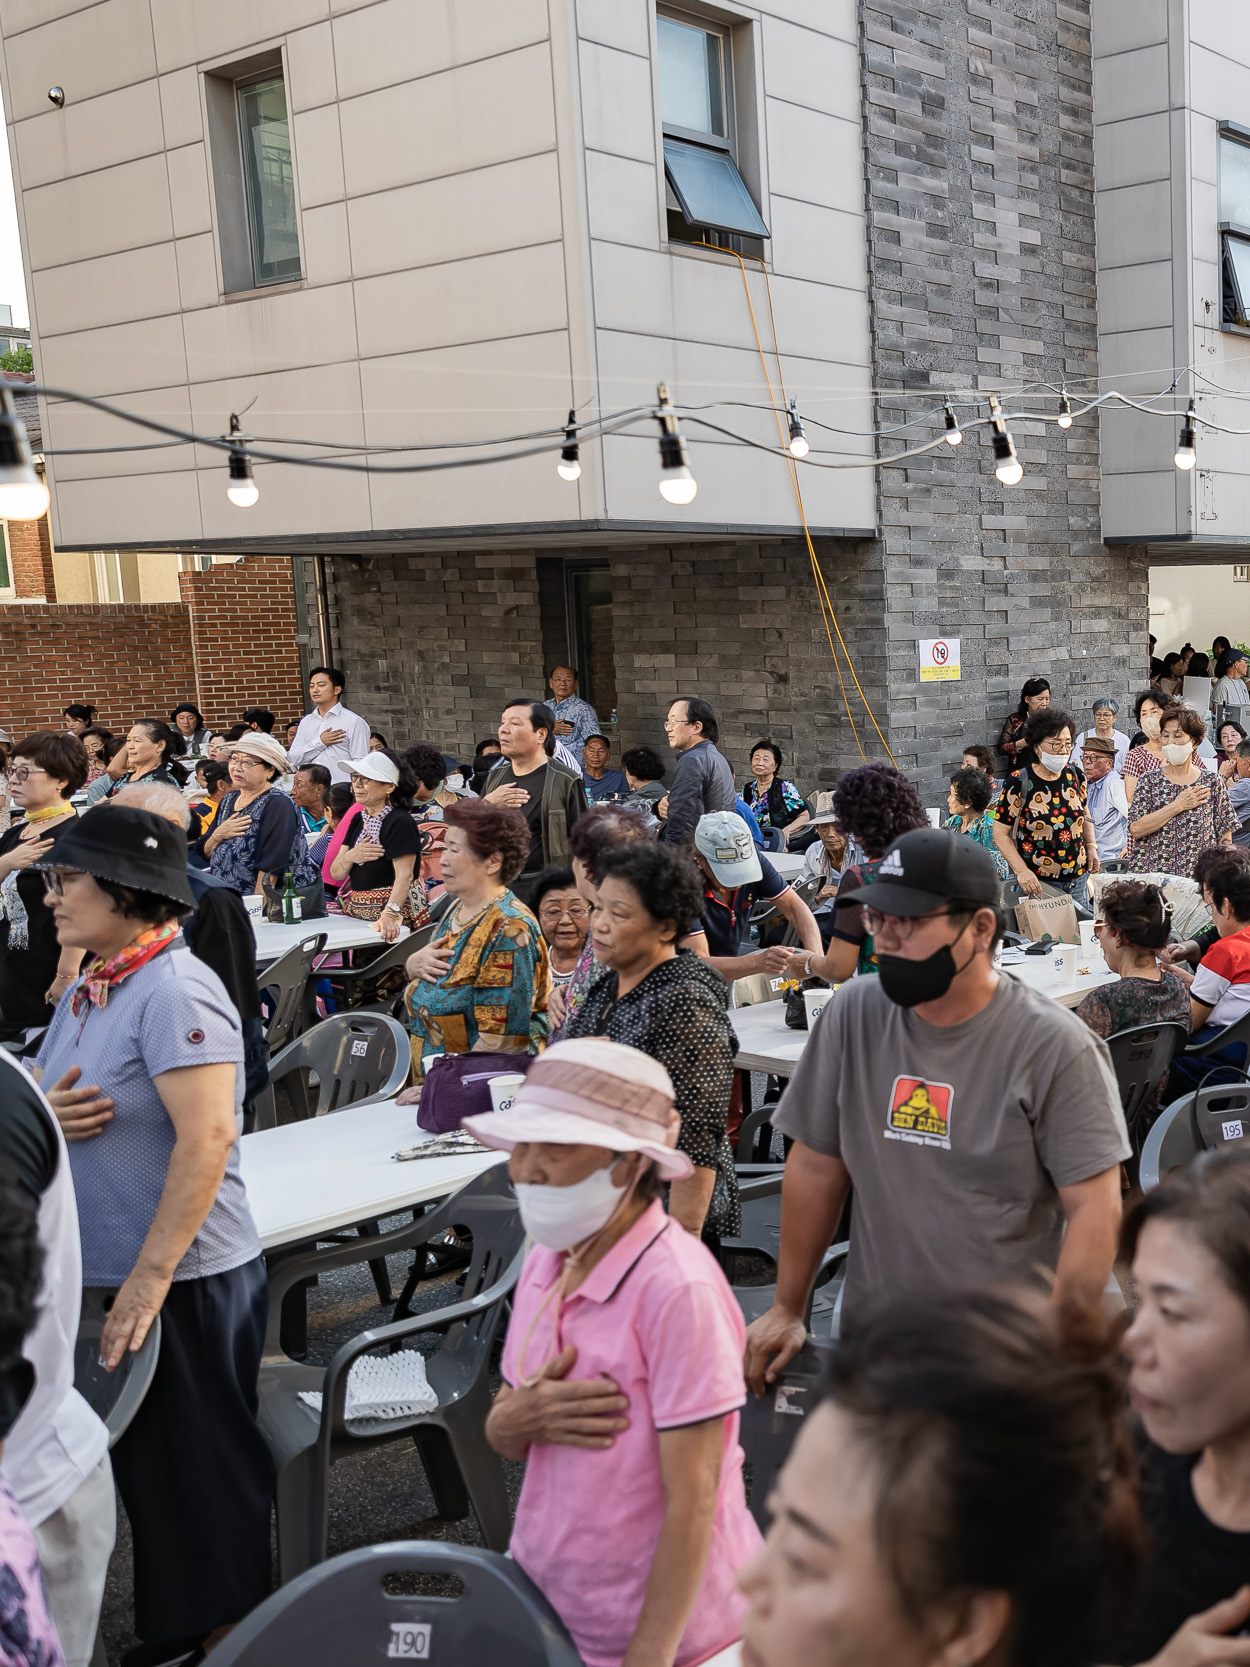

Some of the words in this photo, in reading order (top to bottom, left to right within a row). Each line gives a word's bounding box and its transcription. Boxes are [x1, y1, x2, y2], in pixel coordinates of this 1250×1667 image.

[353, 1042, 366, 1055] 56
[1224, 1124, 1241, 1138] 195
[391, 1631, 426, 1655] 190
